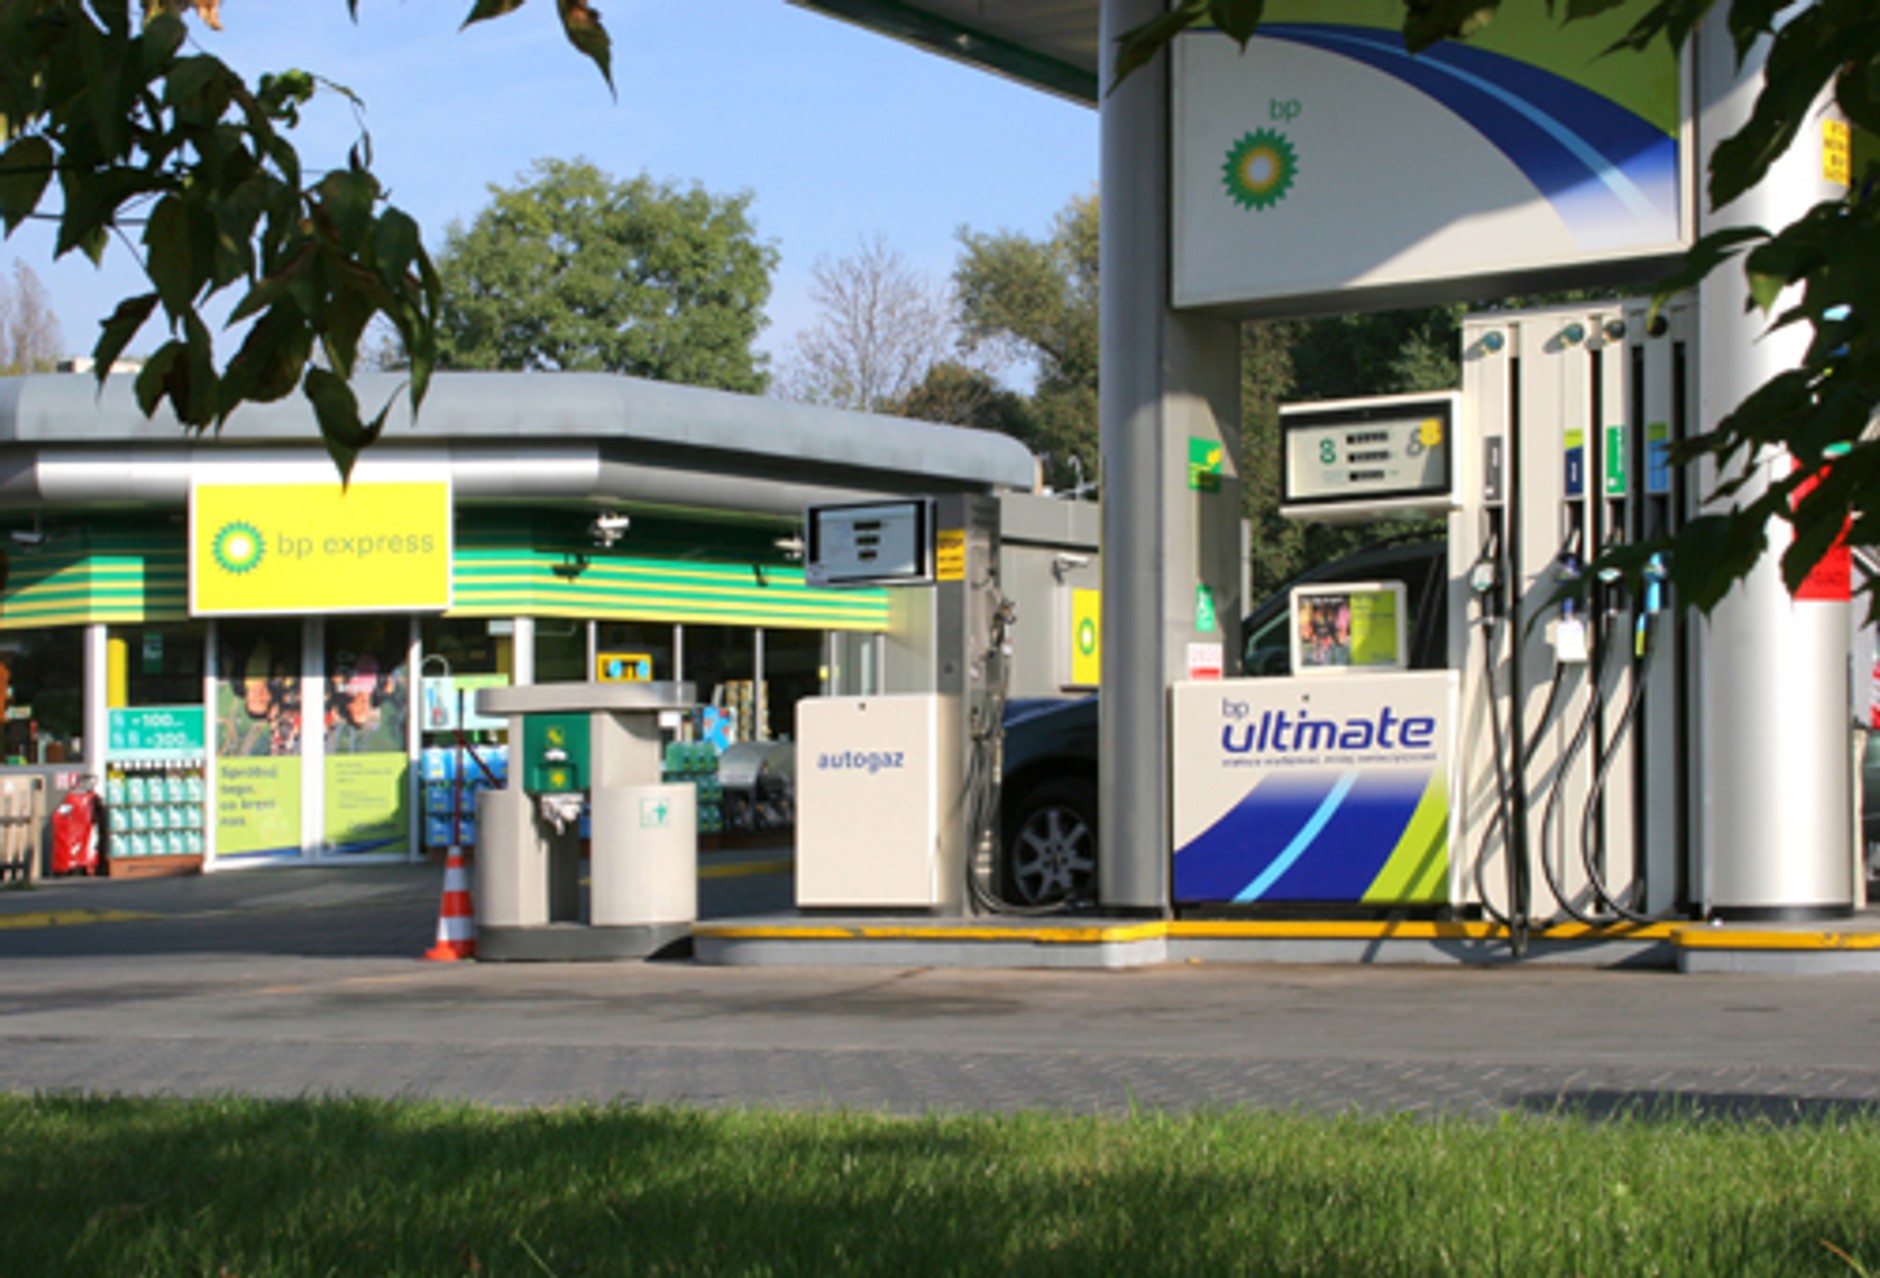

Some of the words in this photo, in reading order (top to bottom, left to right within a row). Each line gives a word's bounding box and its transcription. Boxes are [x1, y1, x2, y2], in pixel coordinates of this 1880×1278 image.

[1269, 97, 1302, 123] bp
[277, 531, 314, 560] bp
[323, 533, 434, 558] express
[1221, 697, 1249, 720] bp
[1221, 706, 1436, 753] ultimate
[816, 750, 905, 775] autogaz
